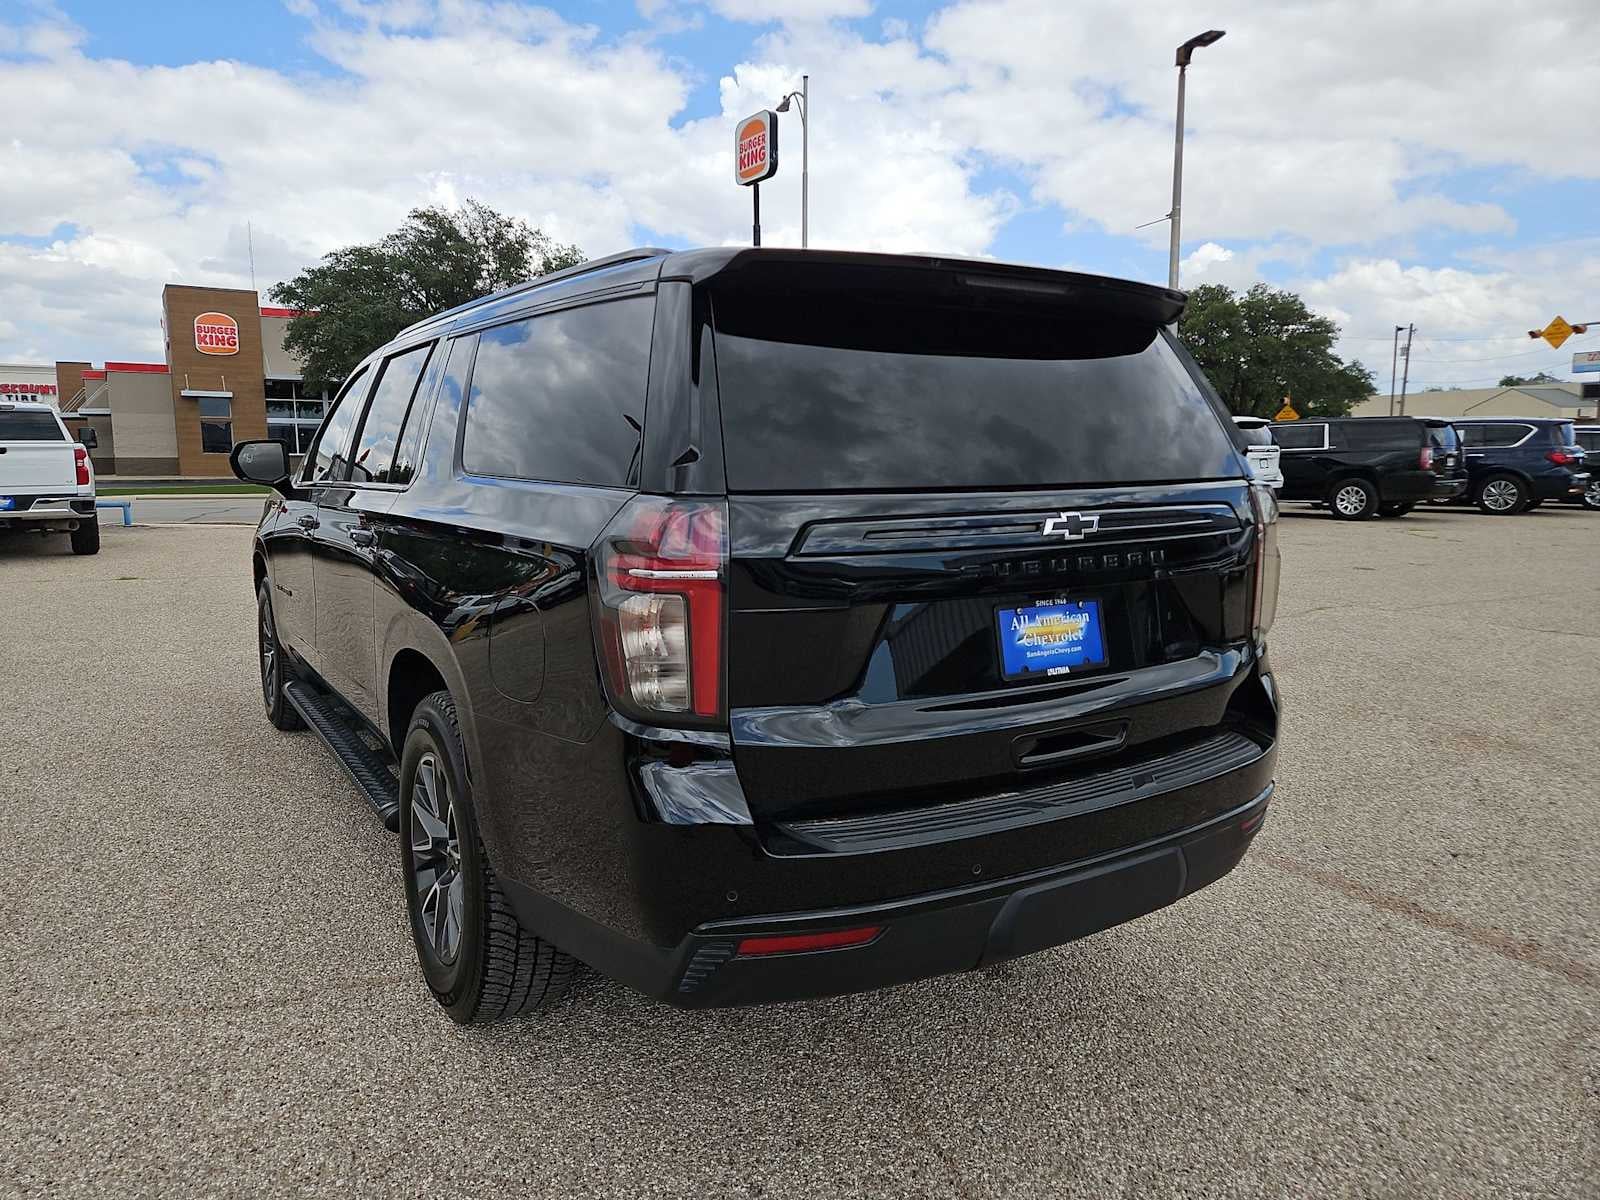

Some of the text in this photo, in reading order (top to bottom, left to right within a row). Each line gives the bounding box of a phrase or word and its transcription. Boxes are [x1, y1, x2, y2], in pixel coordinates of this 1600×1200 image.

[739, 134, 766, 155] BURGER
[739, 146, 766, 171] KING
[196, 326, 236, 336] BURGER
[197, 334, 237, 346] KING
[5, 394, 38, 402] TIRE
[1035, 600, 1054, 608] SINCE
[1011, 612, 1090, 631] All American
[1023, 630, 1084, 647] Chevrolet
